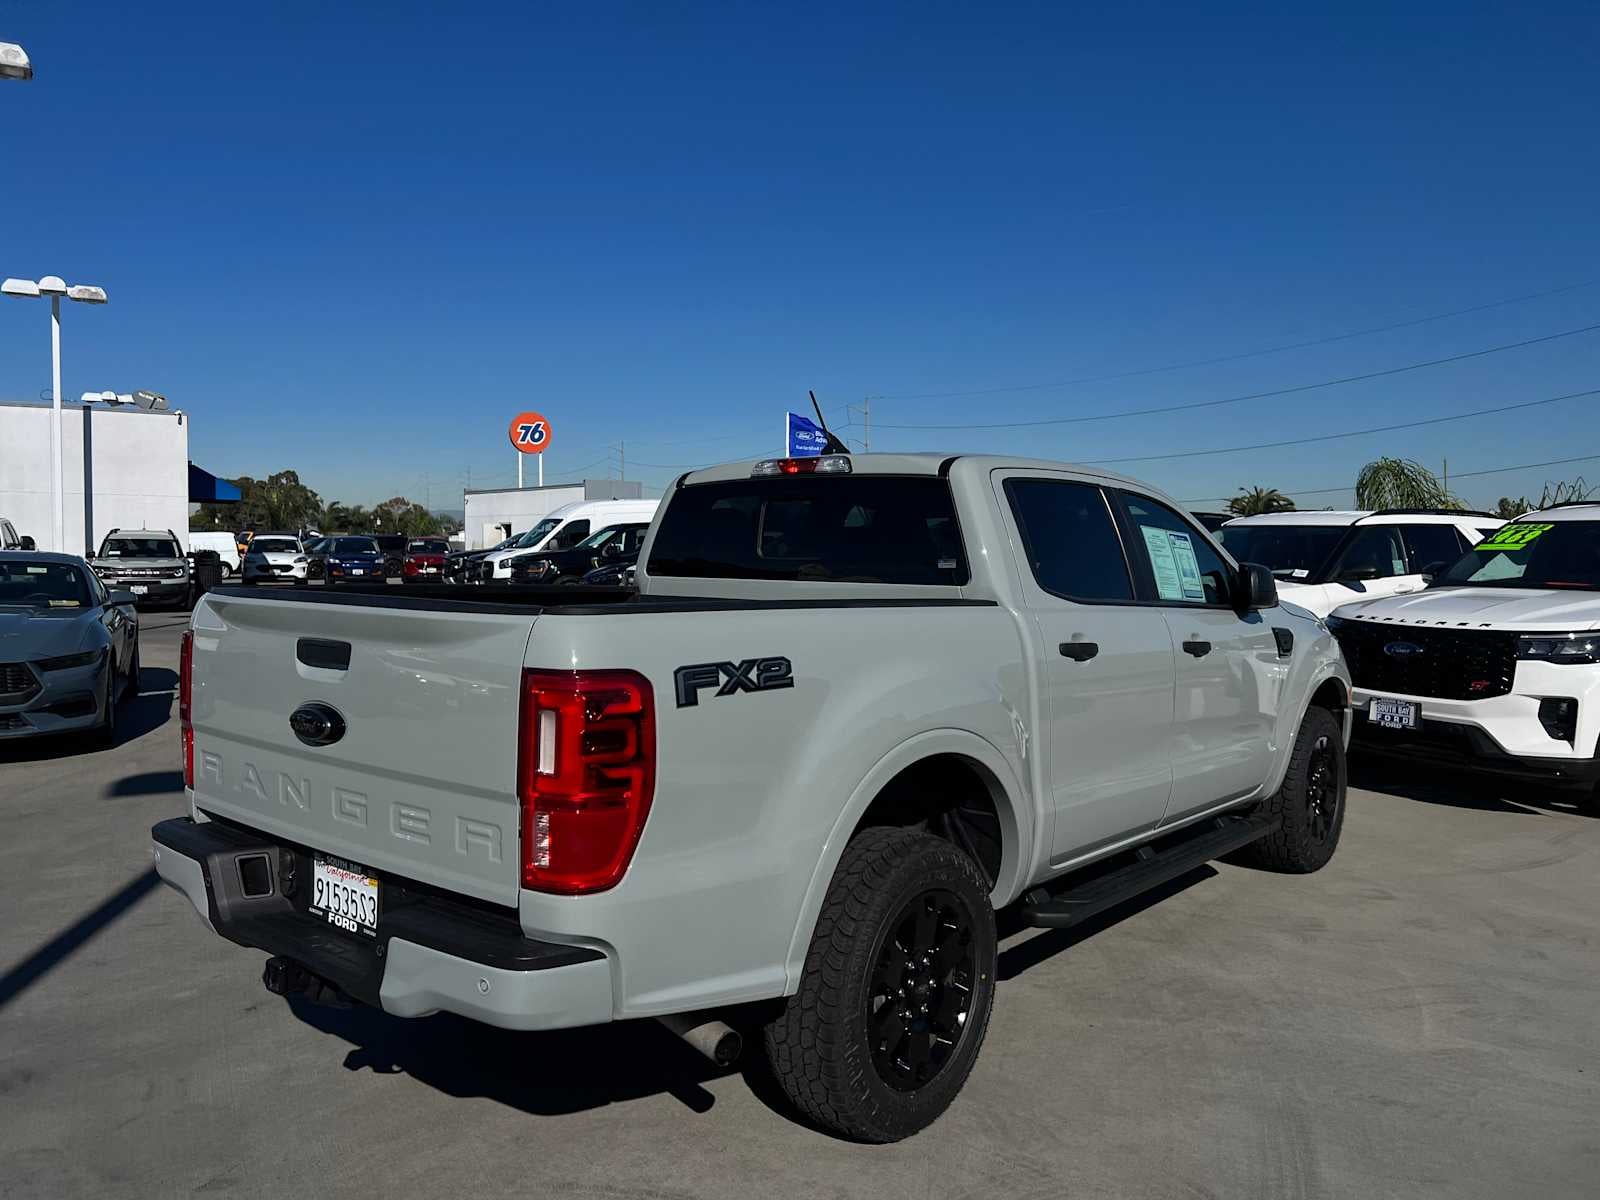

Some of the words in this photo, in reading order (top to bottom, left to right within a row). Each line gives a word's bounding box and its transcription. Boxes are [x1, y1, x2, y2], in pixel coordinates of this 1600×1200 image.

[517, 421, 546, 445] 76
[1354, 614, 1492, 627] EXPLORER
[673, 655, 795, 709] FX2
[1376, 703, 1397, 713] SOUTH
[1398, 706, 1410, 715] BAY
[1377, 713, 1409, 724] FORD
[201, 750, 503, 863] RANGER
[316, 878, 376, 926] 91535S3
[328, 911, 358, 932] FORD
